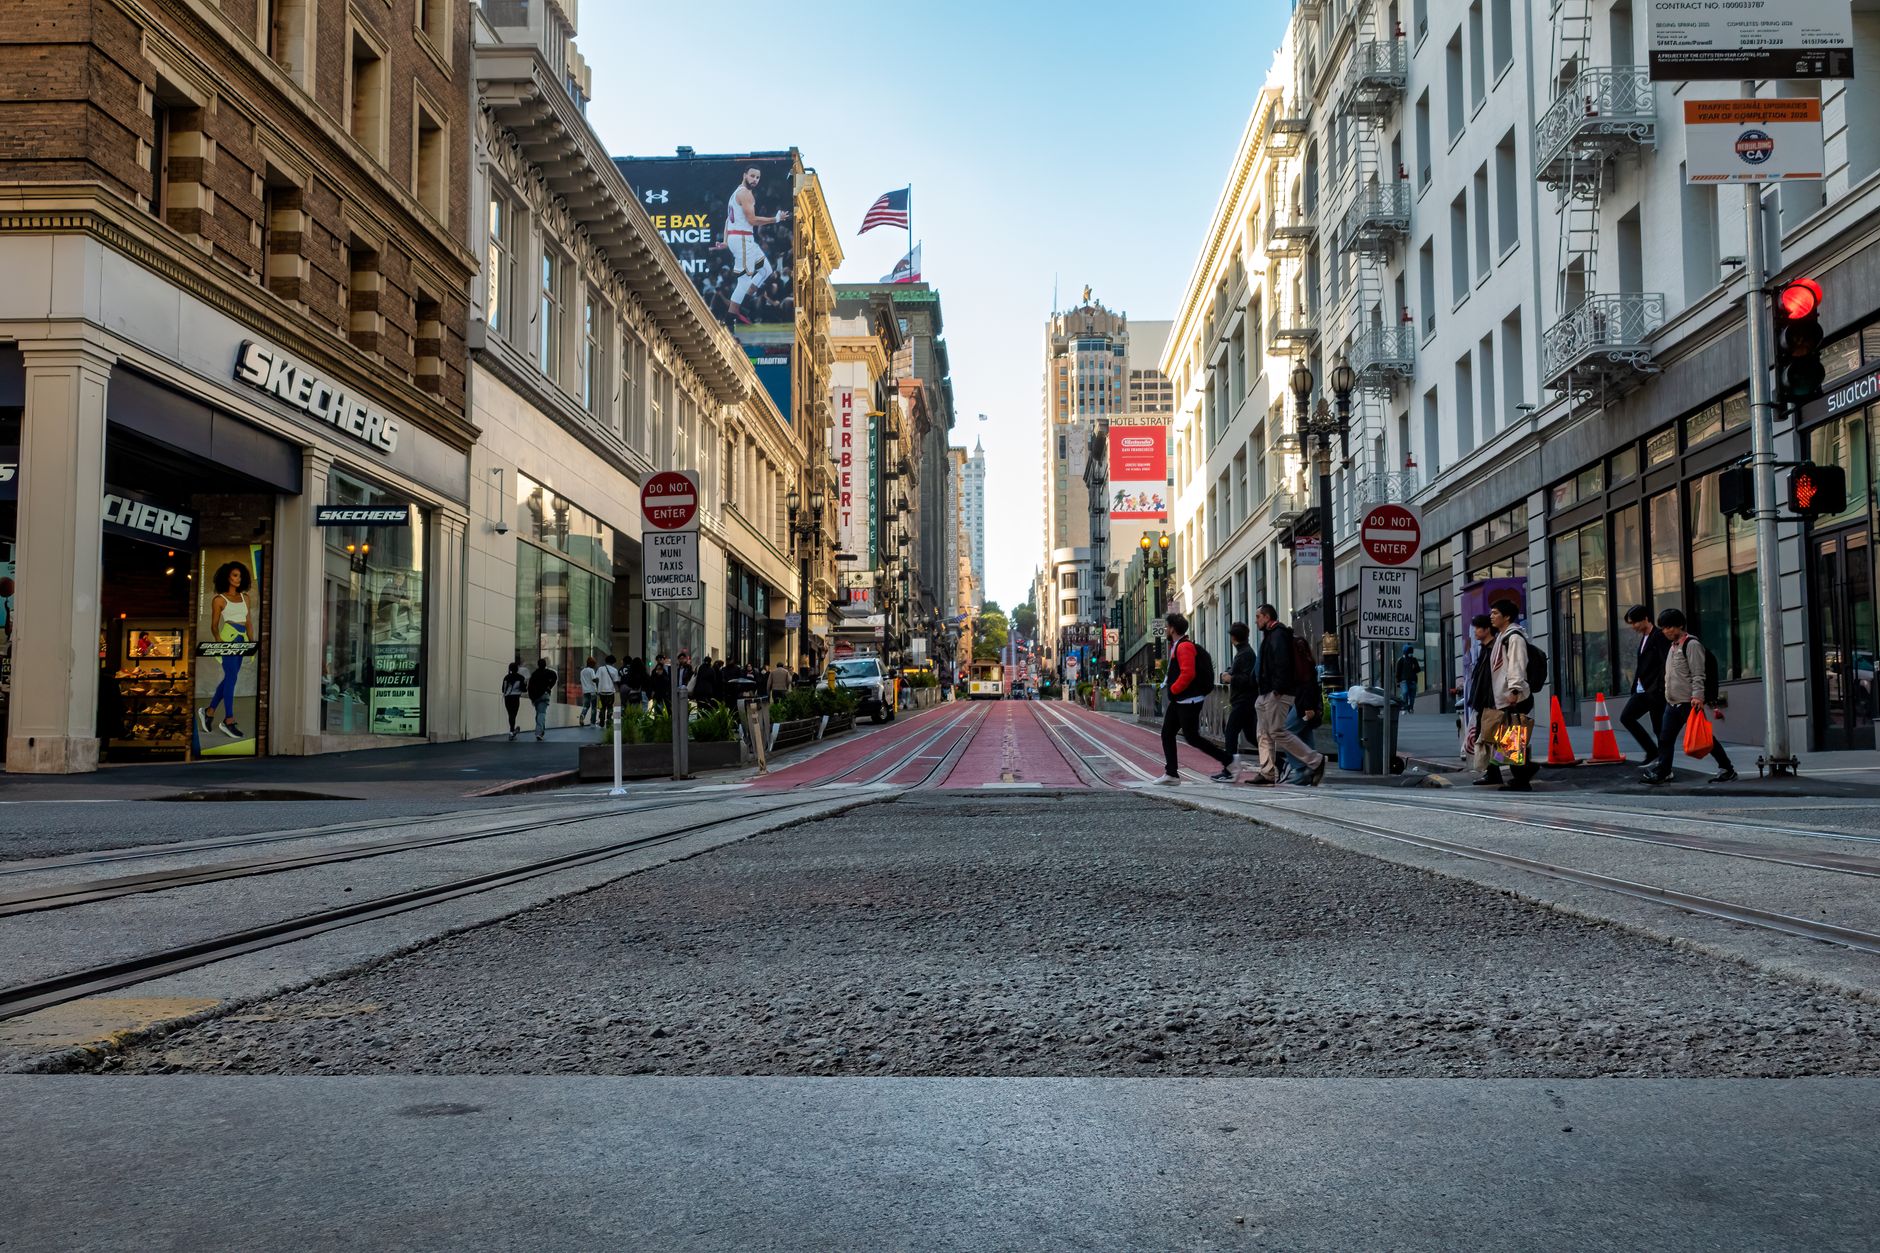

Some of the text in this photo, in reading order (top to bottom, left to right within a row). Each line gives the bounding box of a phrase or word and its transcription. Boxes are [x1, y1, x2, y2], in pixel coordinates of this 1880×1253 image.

[1655, 2, 1702, 10] CONTRACT
[1698, 112, 1719, 120] YEAR
[1734, 110, 1787, 119] COMPLETION
[1737, 142, 1772, 152] REBUILDING
[1746, 150, 1764, 159] CA
[670, 214, 711, 229] BAY.
[679, 259, 710, 273] NT.
[233, 339, 399, 455] SKECHERS
[1827, 374, 1877, 413] swatch
[1110, 417, 1138, 426] HOTEL
[869, 435, 877, 470] THE
[841, 392, 852, 527] HERBERT
[649, 482, 689, 493] DO NOT
[102, 493, 193, 541] CHERS
[319, 510, 407, 520] SKECHERS
[654, 508, 686, 519] ENTER
[869, 478, 877, 554] BARNES
[1370, 516, 1412, 527] DO NOT
[654, 535, 687, 546] EXCEPT
[660, 548, 682, 558] MUNI
[1373, 543, 1407, 554] ENTER
[659, 561, 684, 571] TAXIS
[646, 574, 696, 584] COMMERCIAL
[1372, 571, 1407, 582] EXCEPT
[651, 586, 692, 597] VEHICLES
[1378, 585, 1400, 595] MUNI
[1377, 598, 1402, 609] TAXIS
[1362, 611, 1414, 623] COMMERCIAL
[1152, 627, 1164, 636] 20
[1367, 625, 1410, 636] VEHICLES
[376, 675, 415, 684] WIDE FIT
[375, 690, 391, 698] JUST
